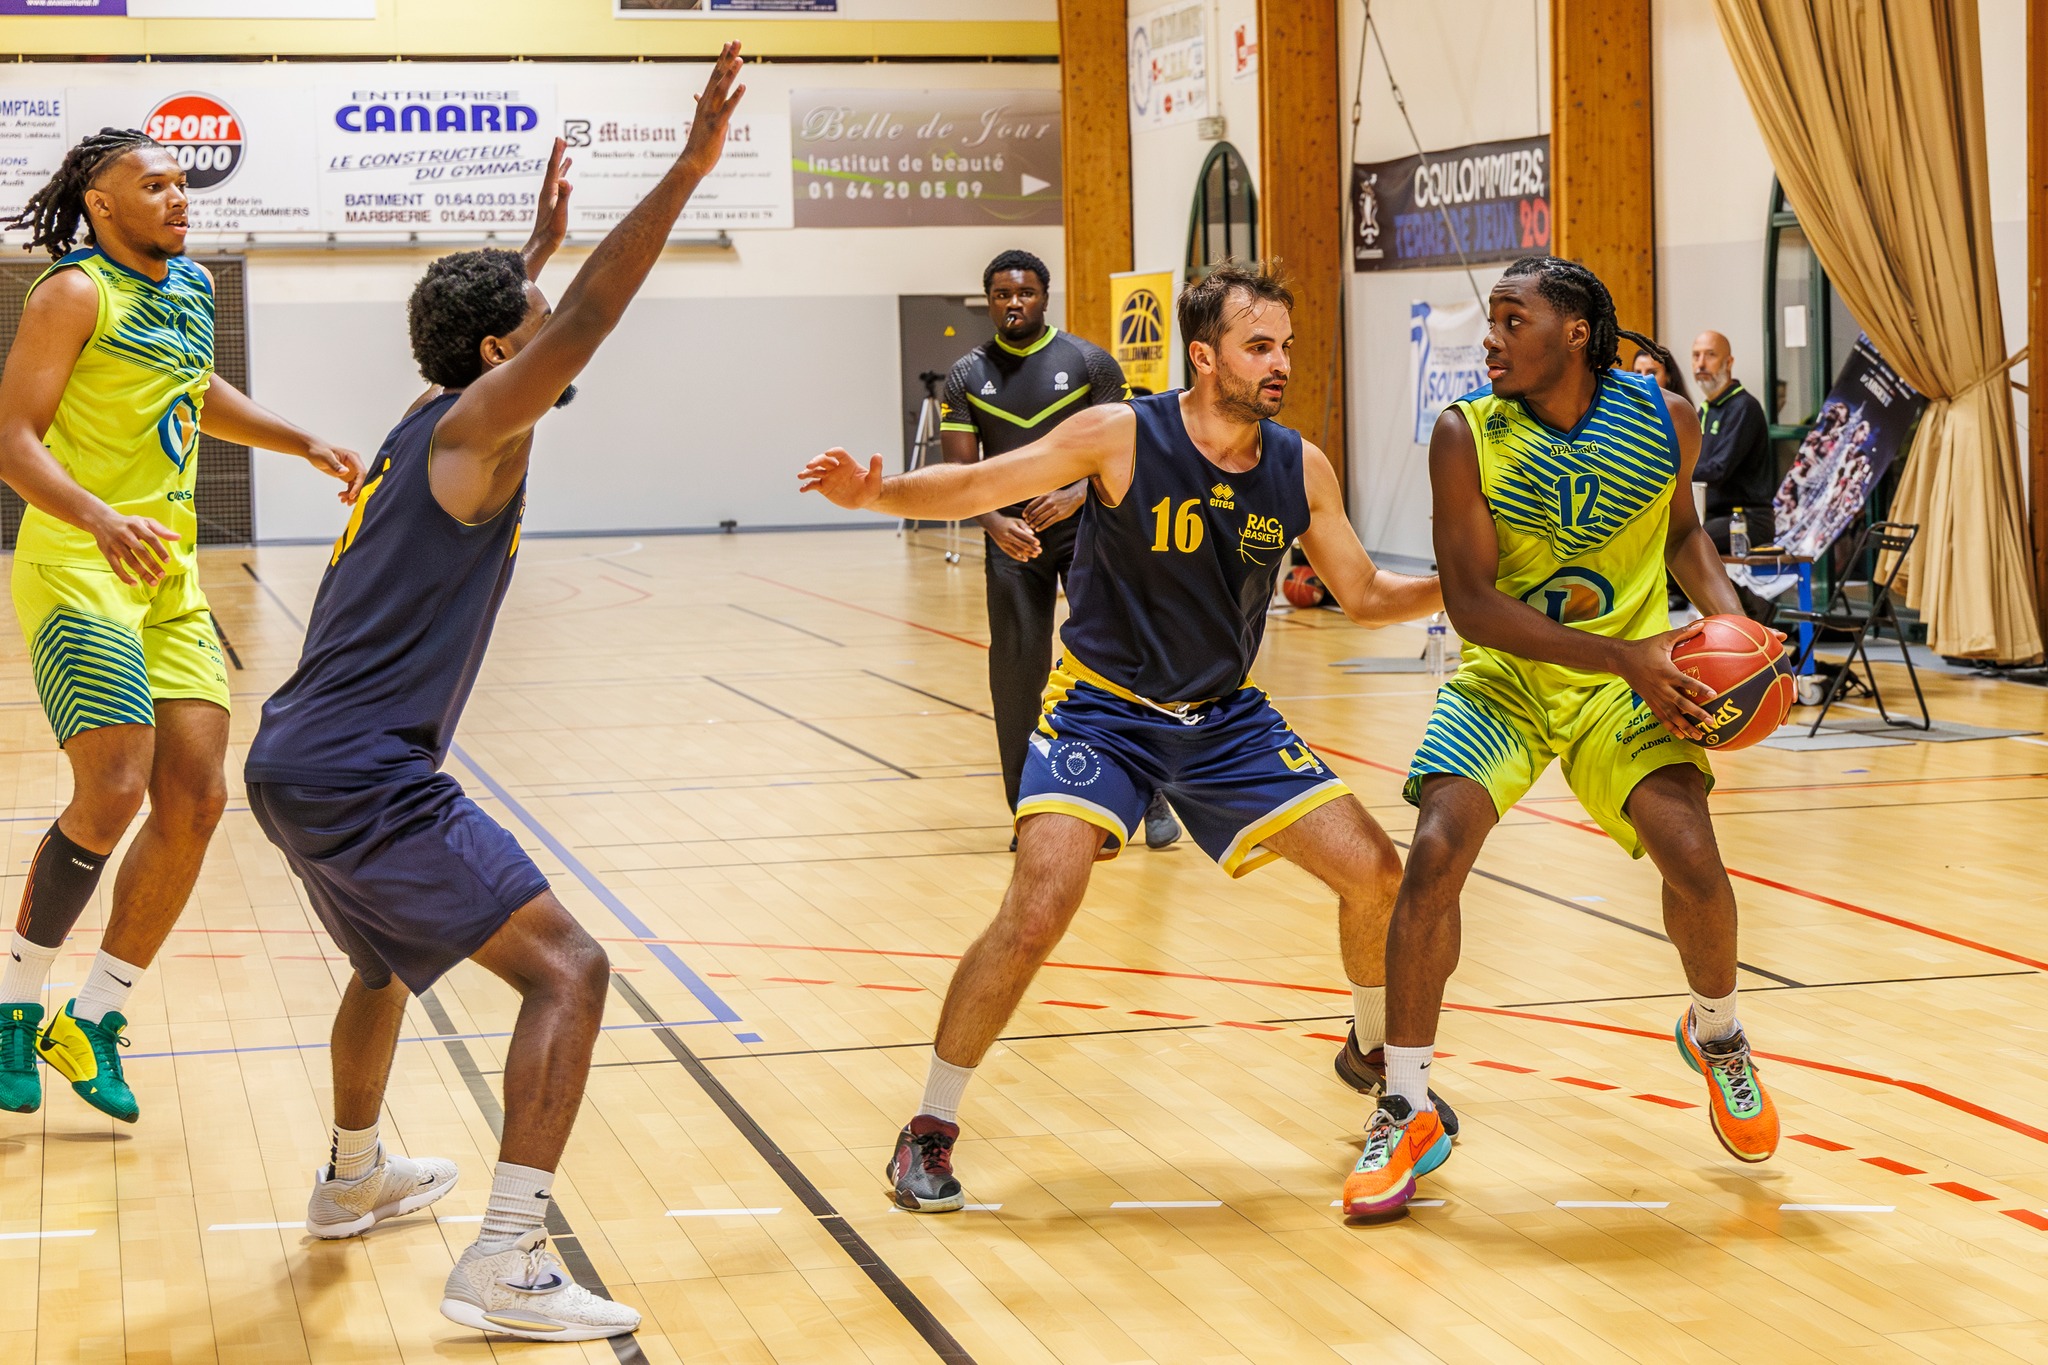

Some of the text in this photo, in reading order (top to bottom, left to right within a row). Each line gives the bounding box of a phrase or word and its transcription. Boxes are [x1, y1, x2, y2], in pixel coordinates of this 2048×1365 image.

[351, 90, 519, 101] ENTREPRISE
[148, 115, 233, 140] SPORT
[335, 104, 538, 133] CANARD
[800, 104, 1051, 148] Belle de Jour
[598, 122, 676, 142] Maison
[329, 143, 521, 169] LE CONSTRUCTEUR
[808, 153, 1005, 173] Institut de beauté
[415, 158, 548, 181] DU GYMNASE
[1414, 148, 1545, 208] COULOMMIERS,
[344, 193, 425, 206] BATIMENT
[808, 181, 983, 200] 01 64 20 05 09
[214, 207, 310, 217] COULOMMIERS
[344, 209, 432, 223] MARBRERIE
[1394, 212, 1446, 259] TERRE
[1473, 200, 1519, 251] JEUX
[1209, 497, 1236, 510] errea
[1553, 473, 1602, 529] 12
[1151, 496, 1204, 553] 16
[1247, 513, 1279, 534] RAC
[1245, 530, 1279, 544] BASKET
[71, 857, 95, 871] TARMAK
